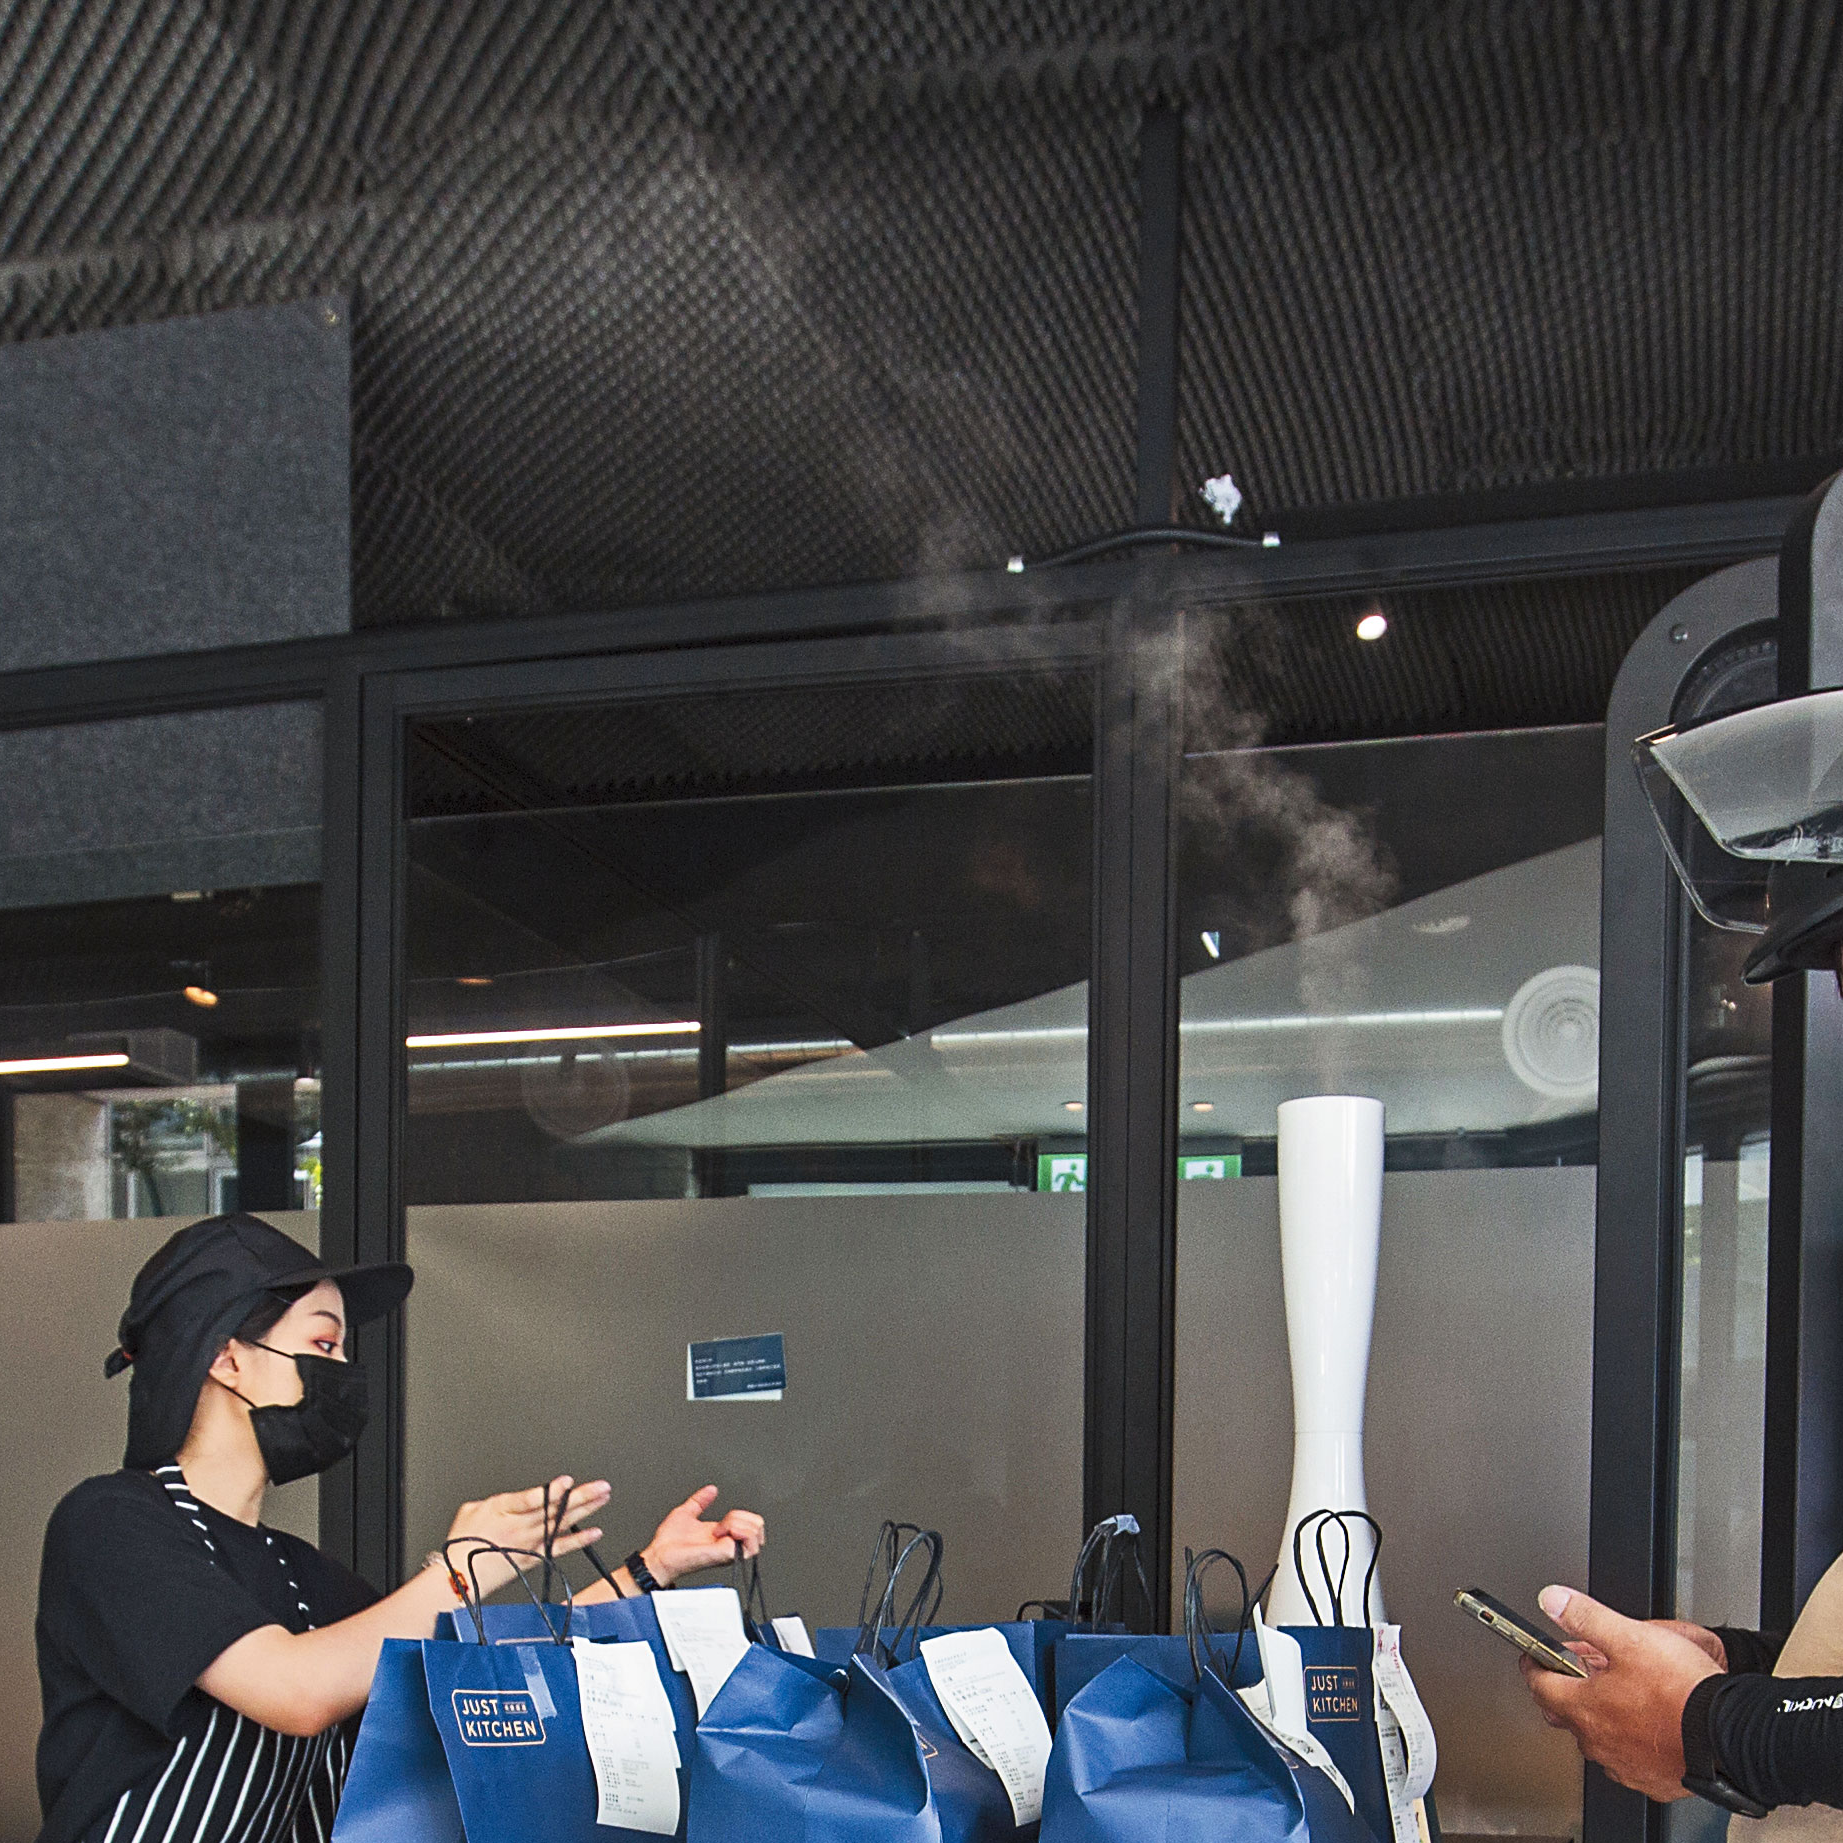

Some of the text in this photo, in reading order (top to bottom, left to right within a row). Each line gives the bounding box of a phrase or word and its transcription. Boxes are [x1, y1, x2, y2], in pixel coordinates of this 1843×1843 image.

[1311, 1675, 1338, 1691] JUST
[462, 1698, 498, 1715] JUST
[1312, 1696, 1358, 1713] KITCHEN
[465, 1720, 537, 1737] KITCHEN
